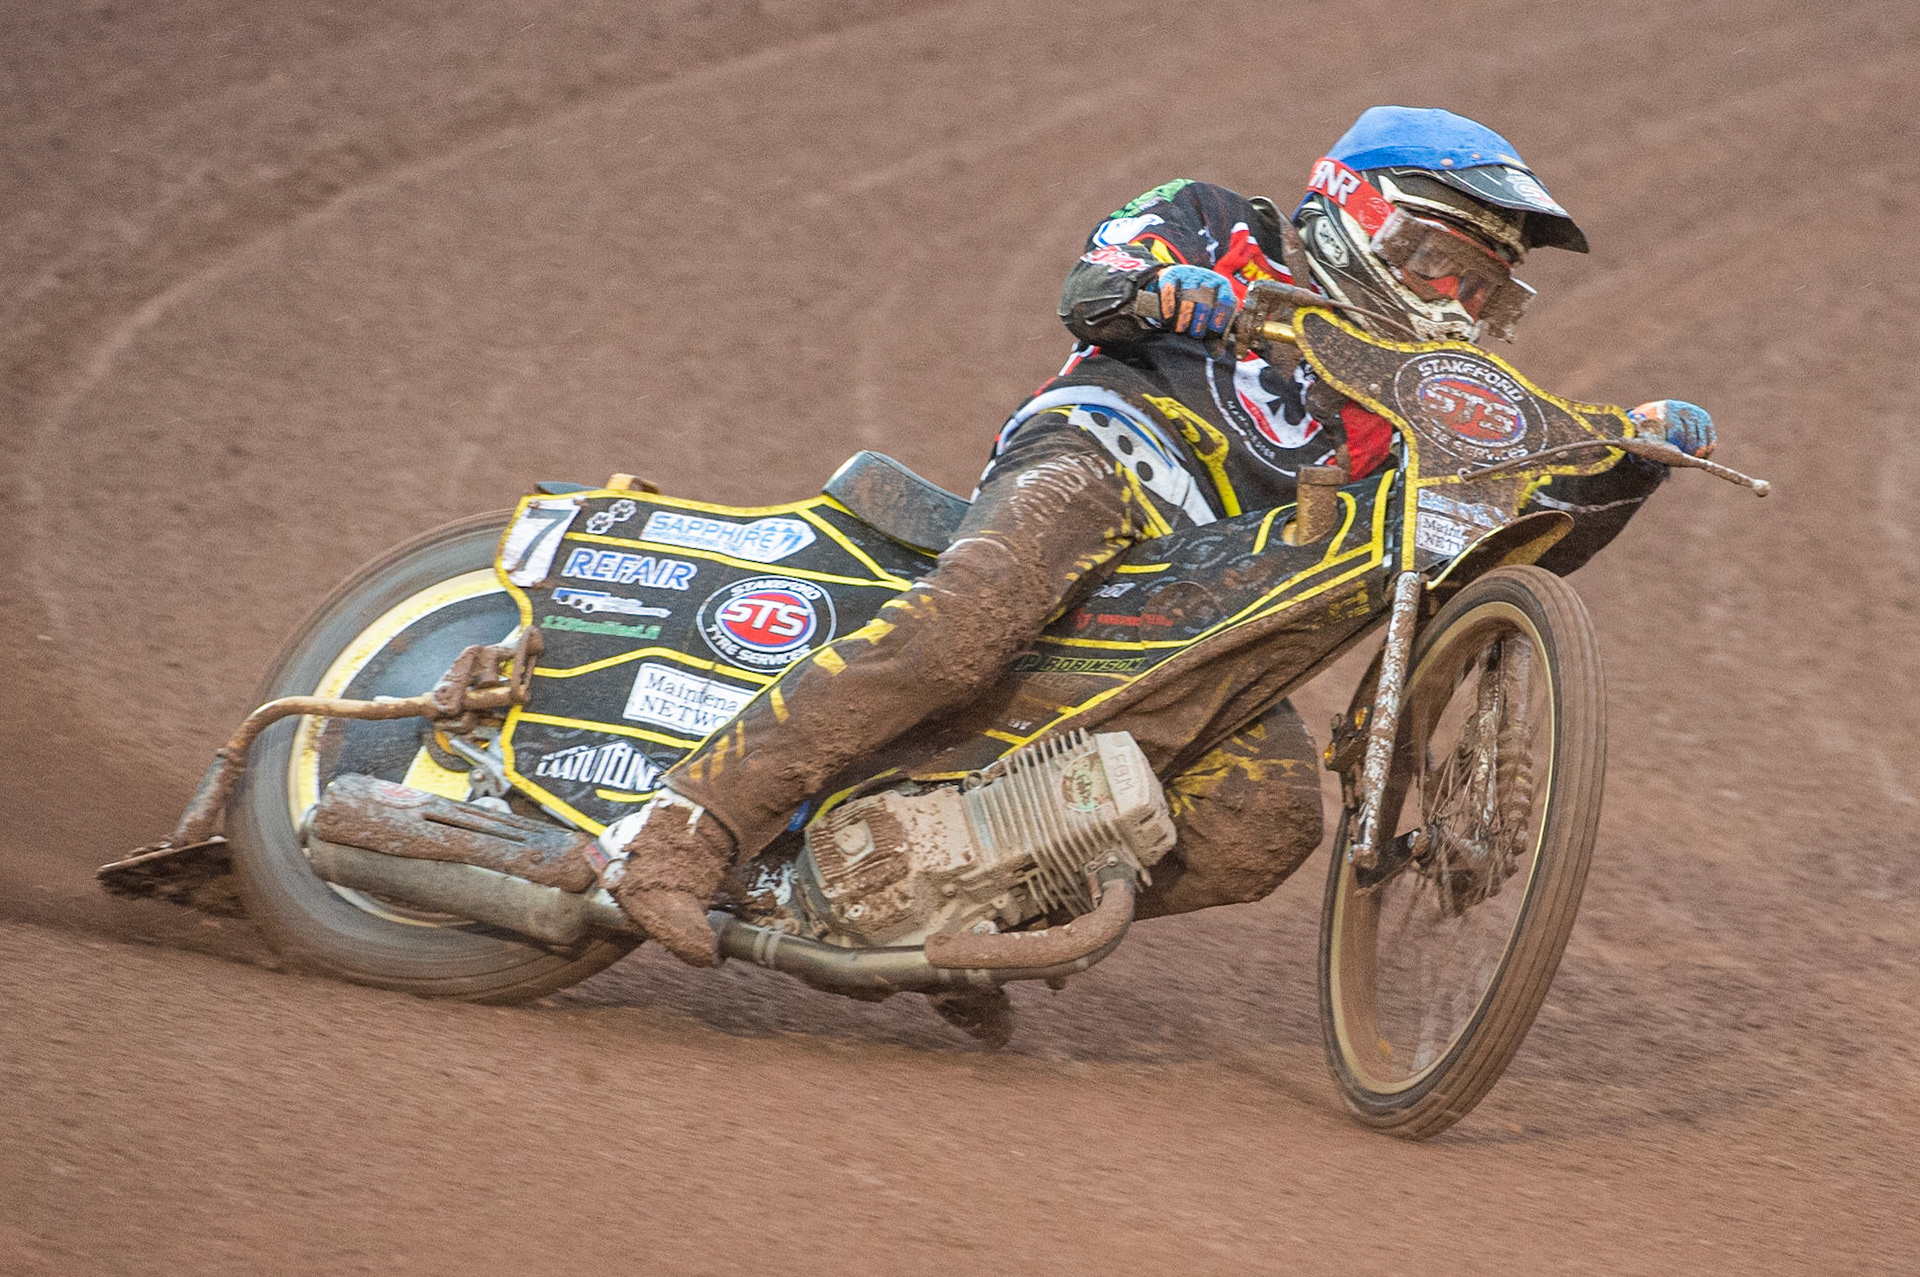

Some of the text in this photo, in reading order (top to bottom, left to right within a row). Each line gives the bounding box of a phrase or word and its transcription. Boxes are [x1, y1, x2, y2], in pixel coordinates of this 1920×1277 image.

[515, 508, 573, 571] 7
[651, 515, 774, 549] SAPPHIRE
[563, 548, 695, 589] REFAIR
[719, 598, 809, 637] STS
[706, 624, 811, 666] TYRE SERVICES
[1043, 656, 1147, 673] ROBINSON
[645, 672, 738, 712] Maintena
[640, 695, 728, 729] NETWO
